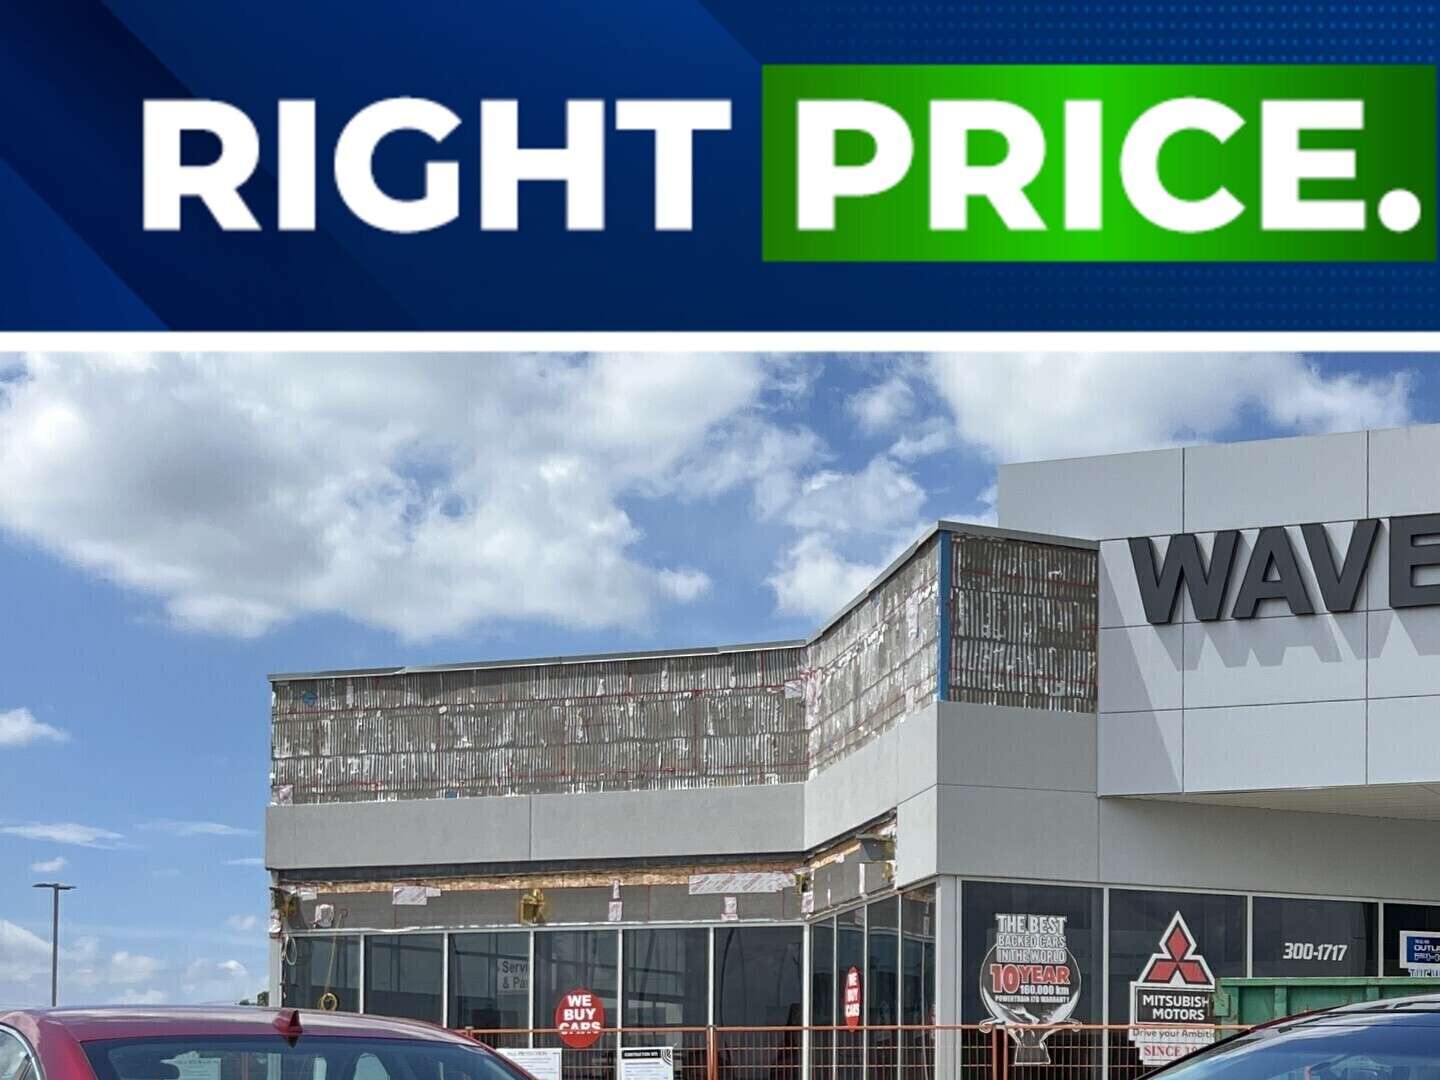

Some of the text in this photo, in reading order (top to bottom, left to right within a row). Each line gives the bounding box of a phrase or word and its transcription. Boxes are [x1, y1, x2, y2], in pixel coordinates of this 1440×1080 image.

[995, 914, 1067, 935] THE BEST
[997, 934, 1067, 948] BACKED CARS
[997, 948, 1067, 964] IN THE WORLD
[1282, 942, 1348, 961] 300-1717
[502, 960, 528, 974] Servi
[990, 963, 1070, 994] 10 YEAR
[567, 994, 593, 1007] WE
[1142, 993, 1210, 1008] MITSUBISH
[563, 1008, 596, 1021] BUY
[1152, 1008, 1206, 1020] MOTORS
[1144, 1045, 1181, 1057] SINCE
